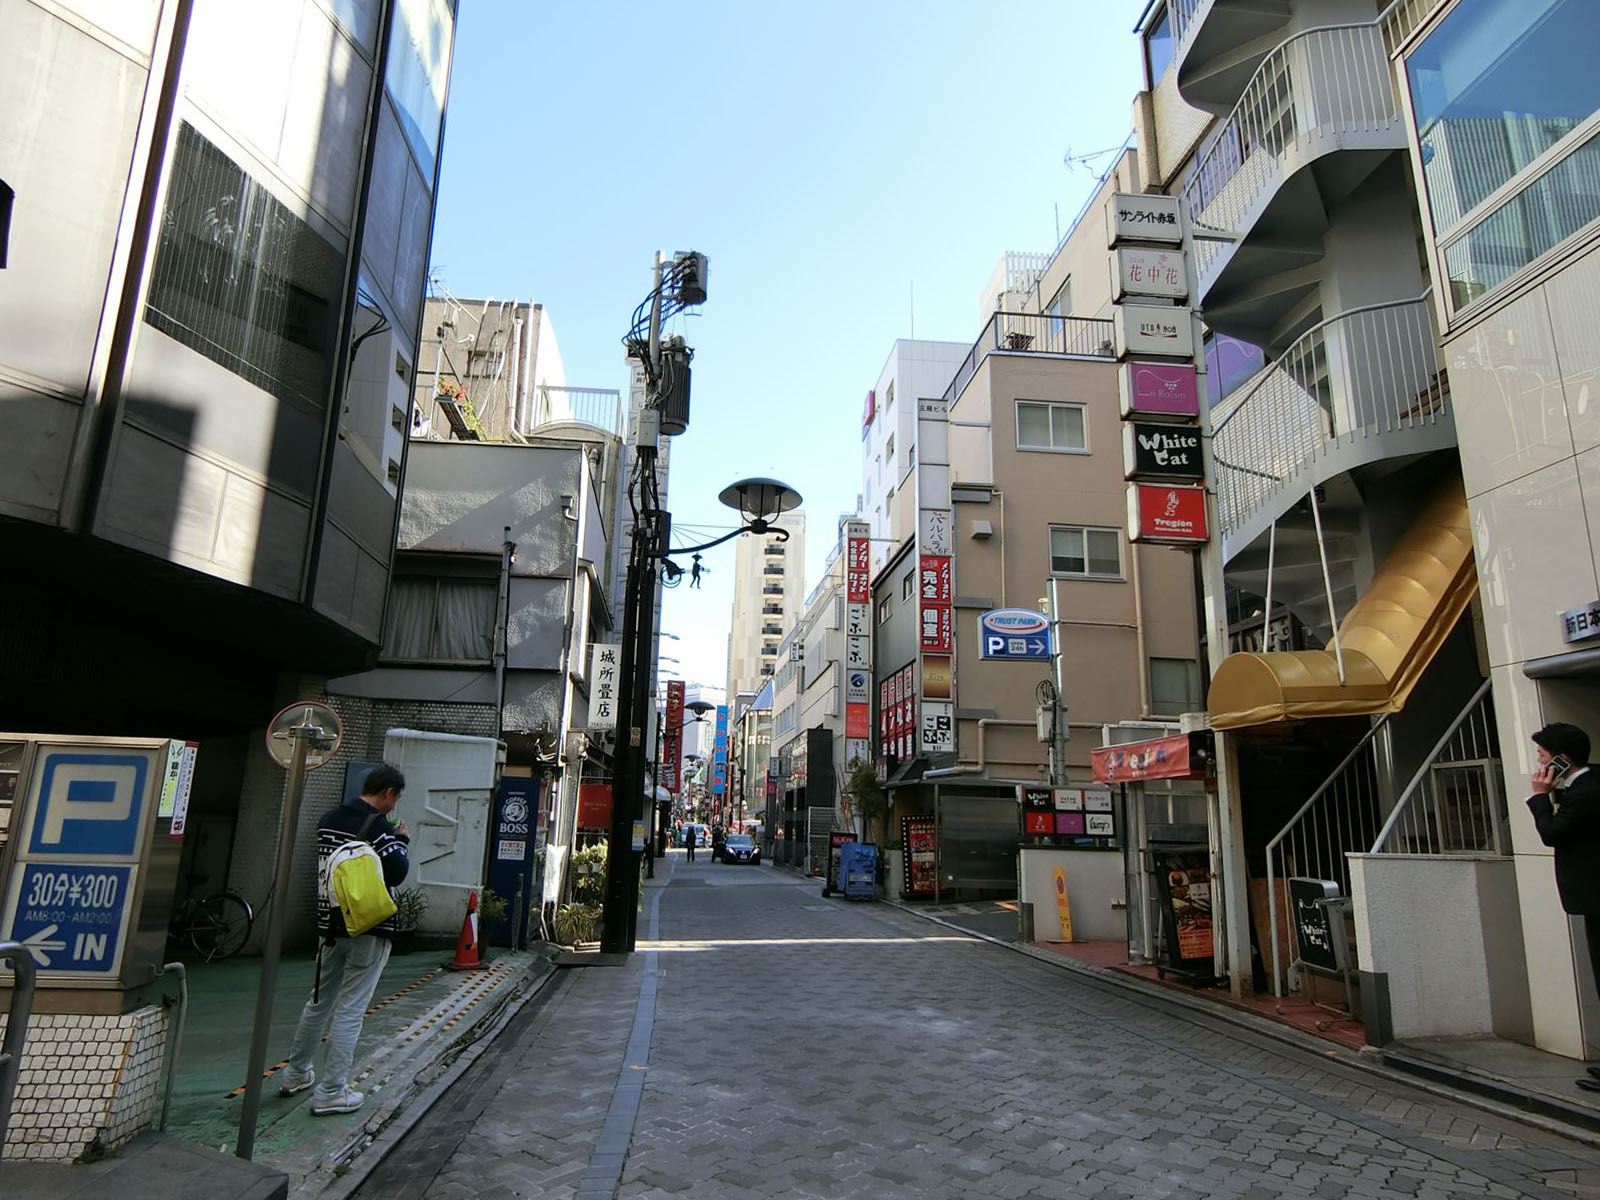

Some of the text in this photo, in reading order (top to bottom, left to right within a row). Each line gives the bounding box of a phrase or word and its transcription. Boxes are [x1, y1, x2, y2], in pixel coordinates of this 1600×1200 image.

[1119, 209, 1177, 225] サンライト赤坂
[1129, 265, 1177, 285] 花中花
[1138, 432, 1197, 450] White
[1153, 449, 1189, 466] Cat
[1154, 518, 1192, 528] Tregion
[993, 617, 1017, 625] TRUST
[988, 636, 1004, 655] P
[596, 650, 615, 719] 城所畳店
[41, 763, 137, 845] P
[505, 796, 527, 805] COFFEE
[1027, 792, 1049, 800] White
[499, 823, 528, 834] BOSS
[1303, 924, 1325, 935] White
[73, 933, 108, 961] IN
[1309, 935, 1323, 946] Cat
